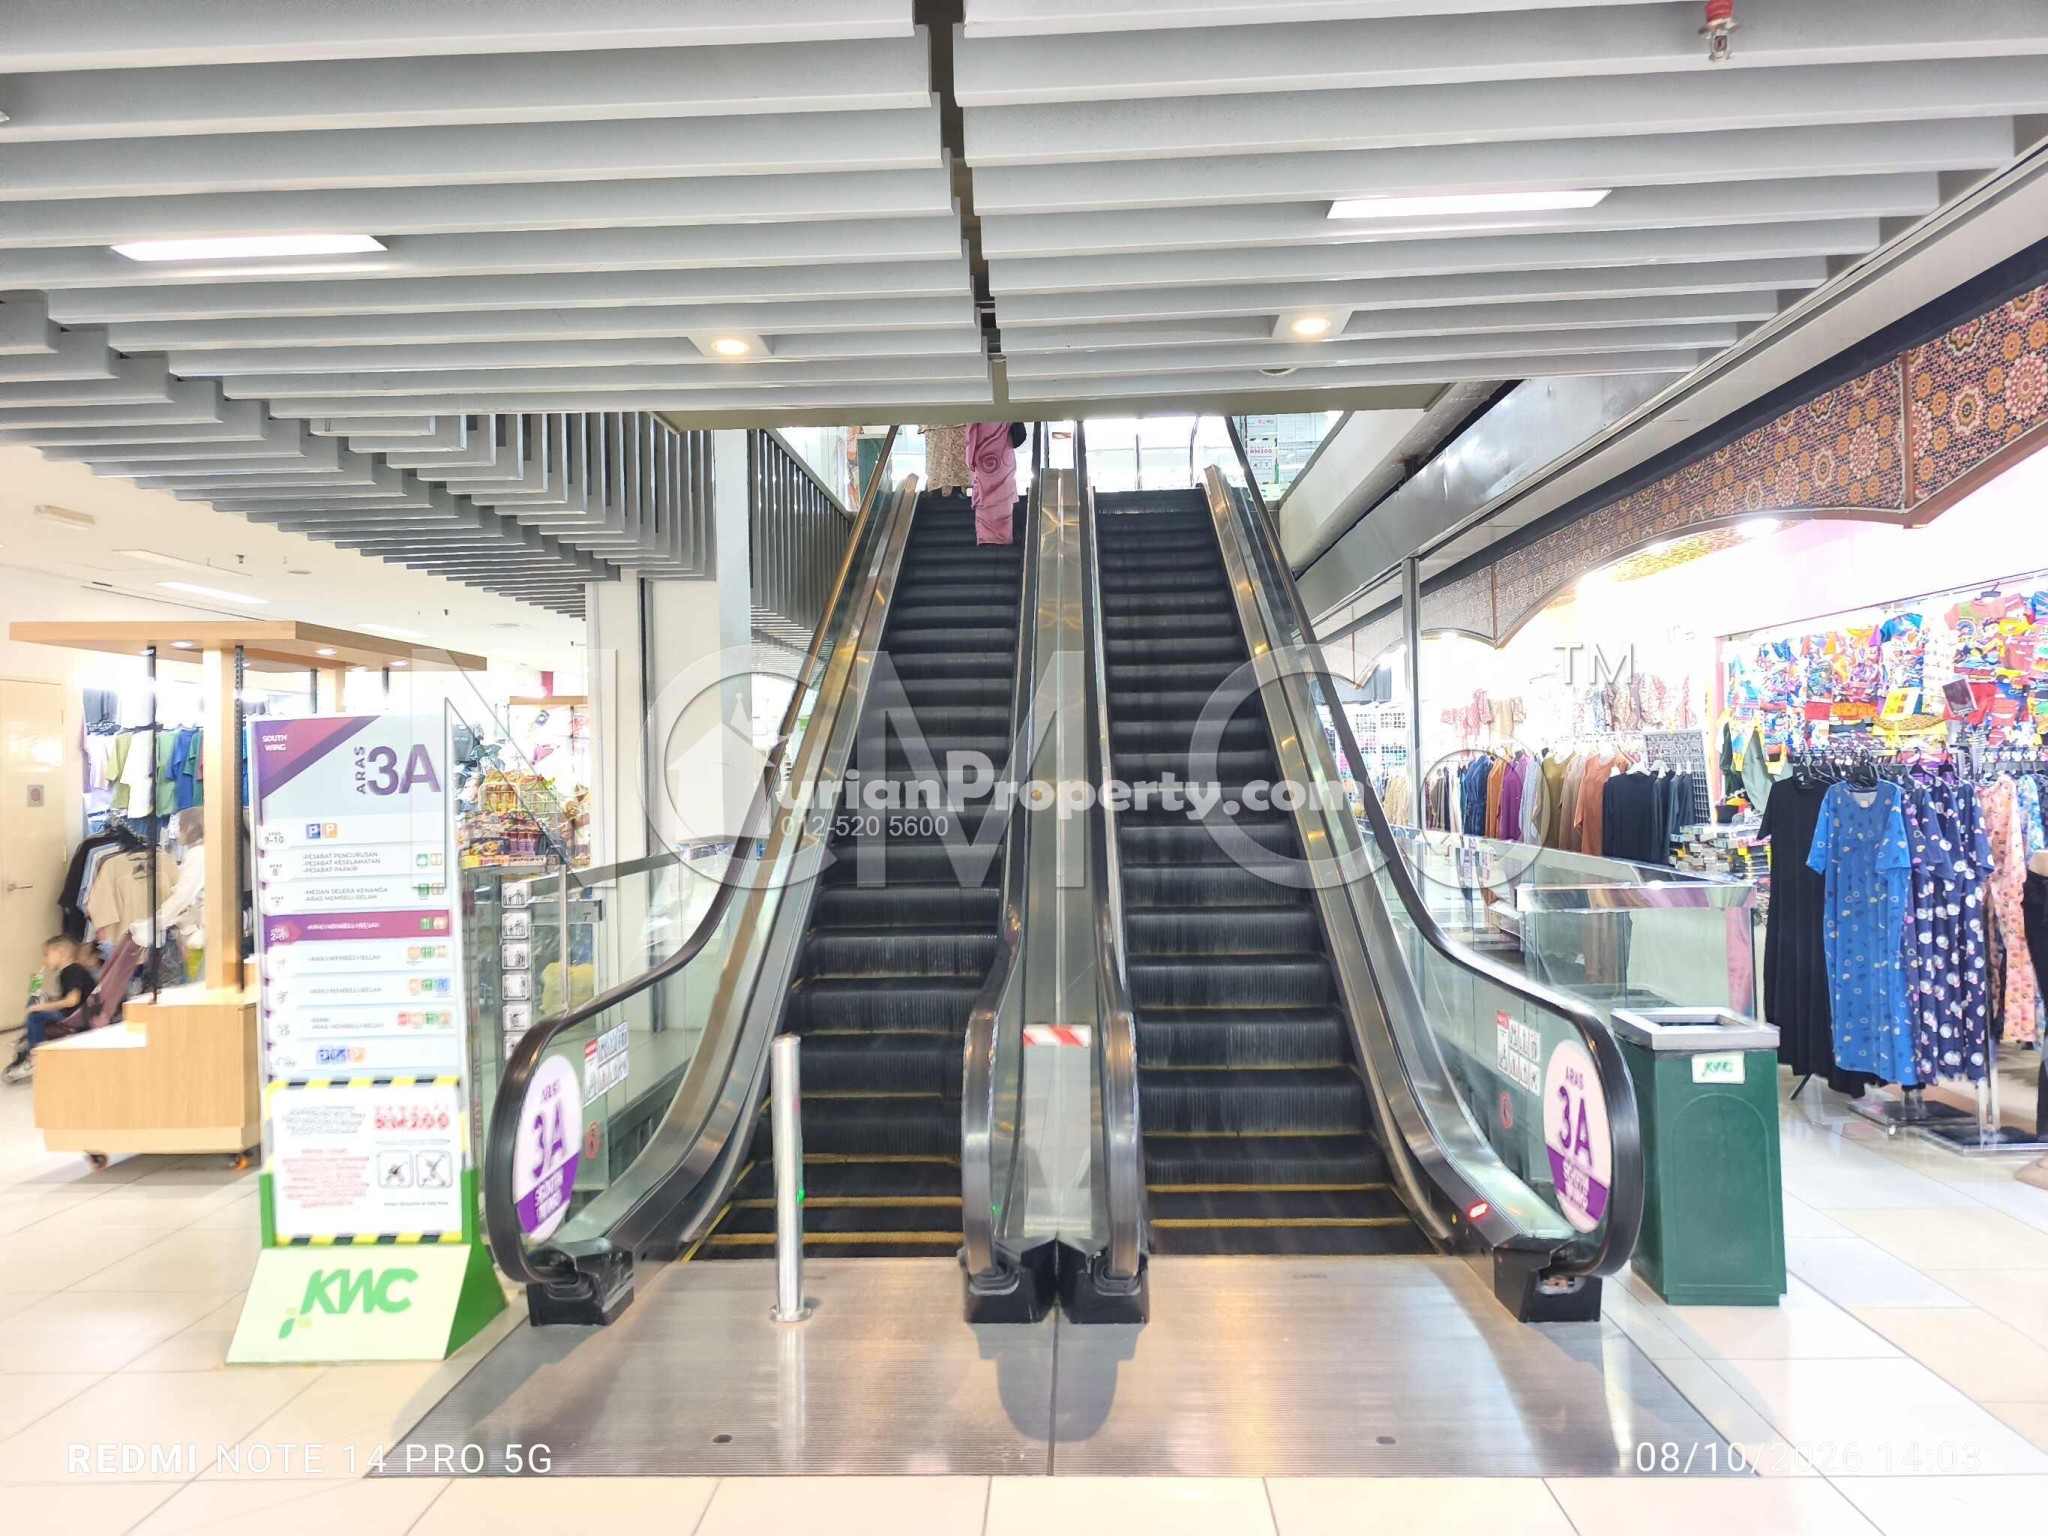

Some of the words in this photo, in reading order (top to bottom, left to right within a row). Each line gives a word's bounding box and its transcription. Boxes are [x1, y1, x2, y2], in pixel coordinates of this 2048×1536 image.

[261, 734, 288, 743] SOUTH
[264, 743, 287, 752] WING
[355, 745, 367, 795] ARAS
[367, 743, 441, 796] 3A
[1564, 1065, 1585, 1091] ARAS
[532, 1102, 565, 1179] 3A
[1558, 1085, 1593, 1167] 3A
[299, 1268, 419, 1315] KWC
